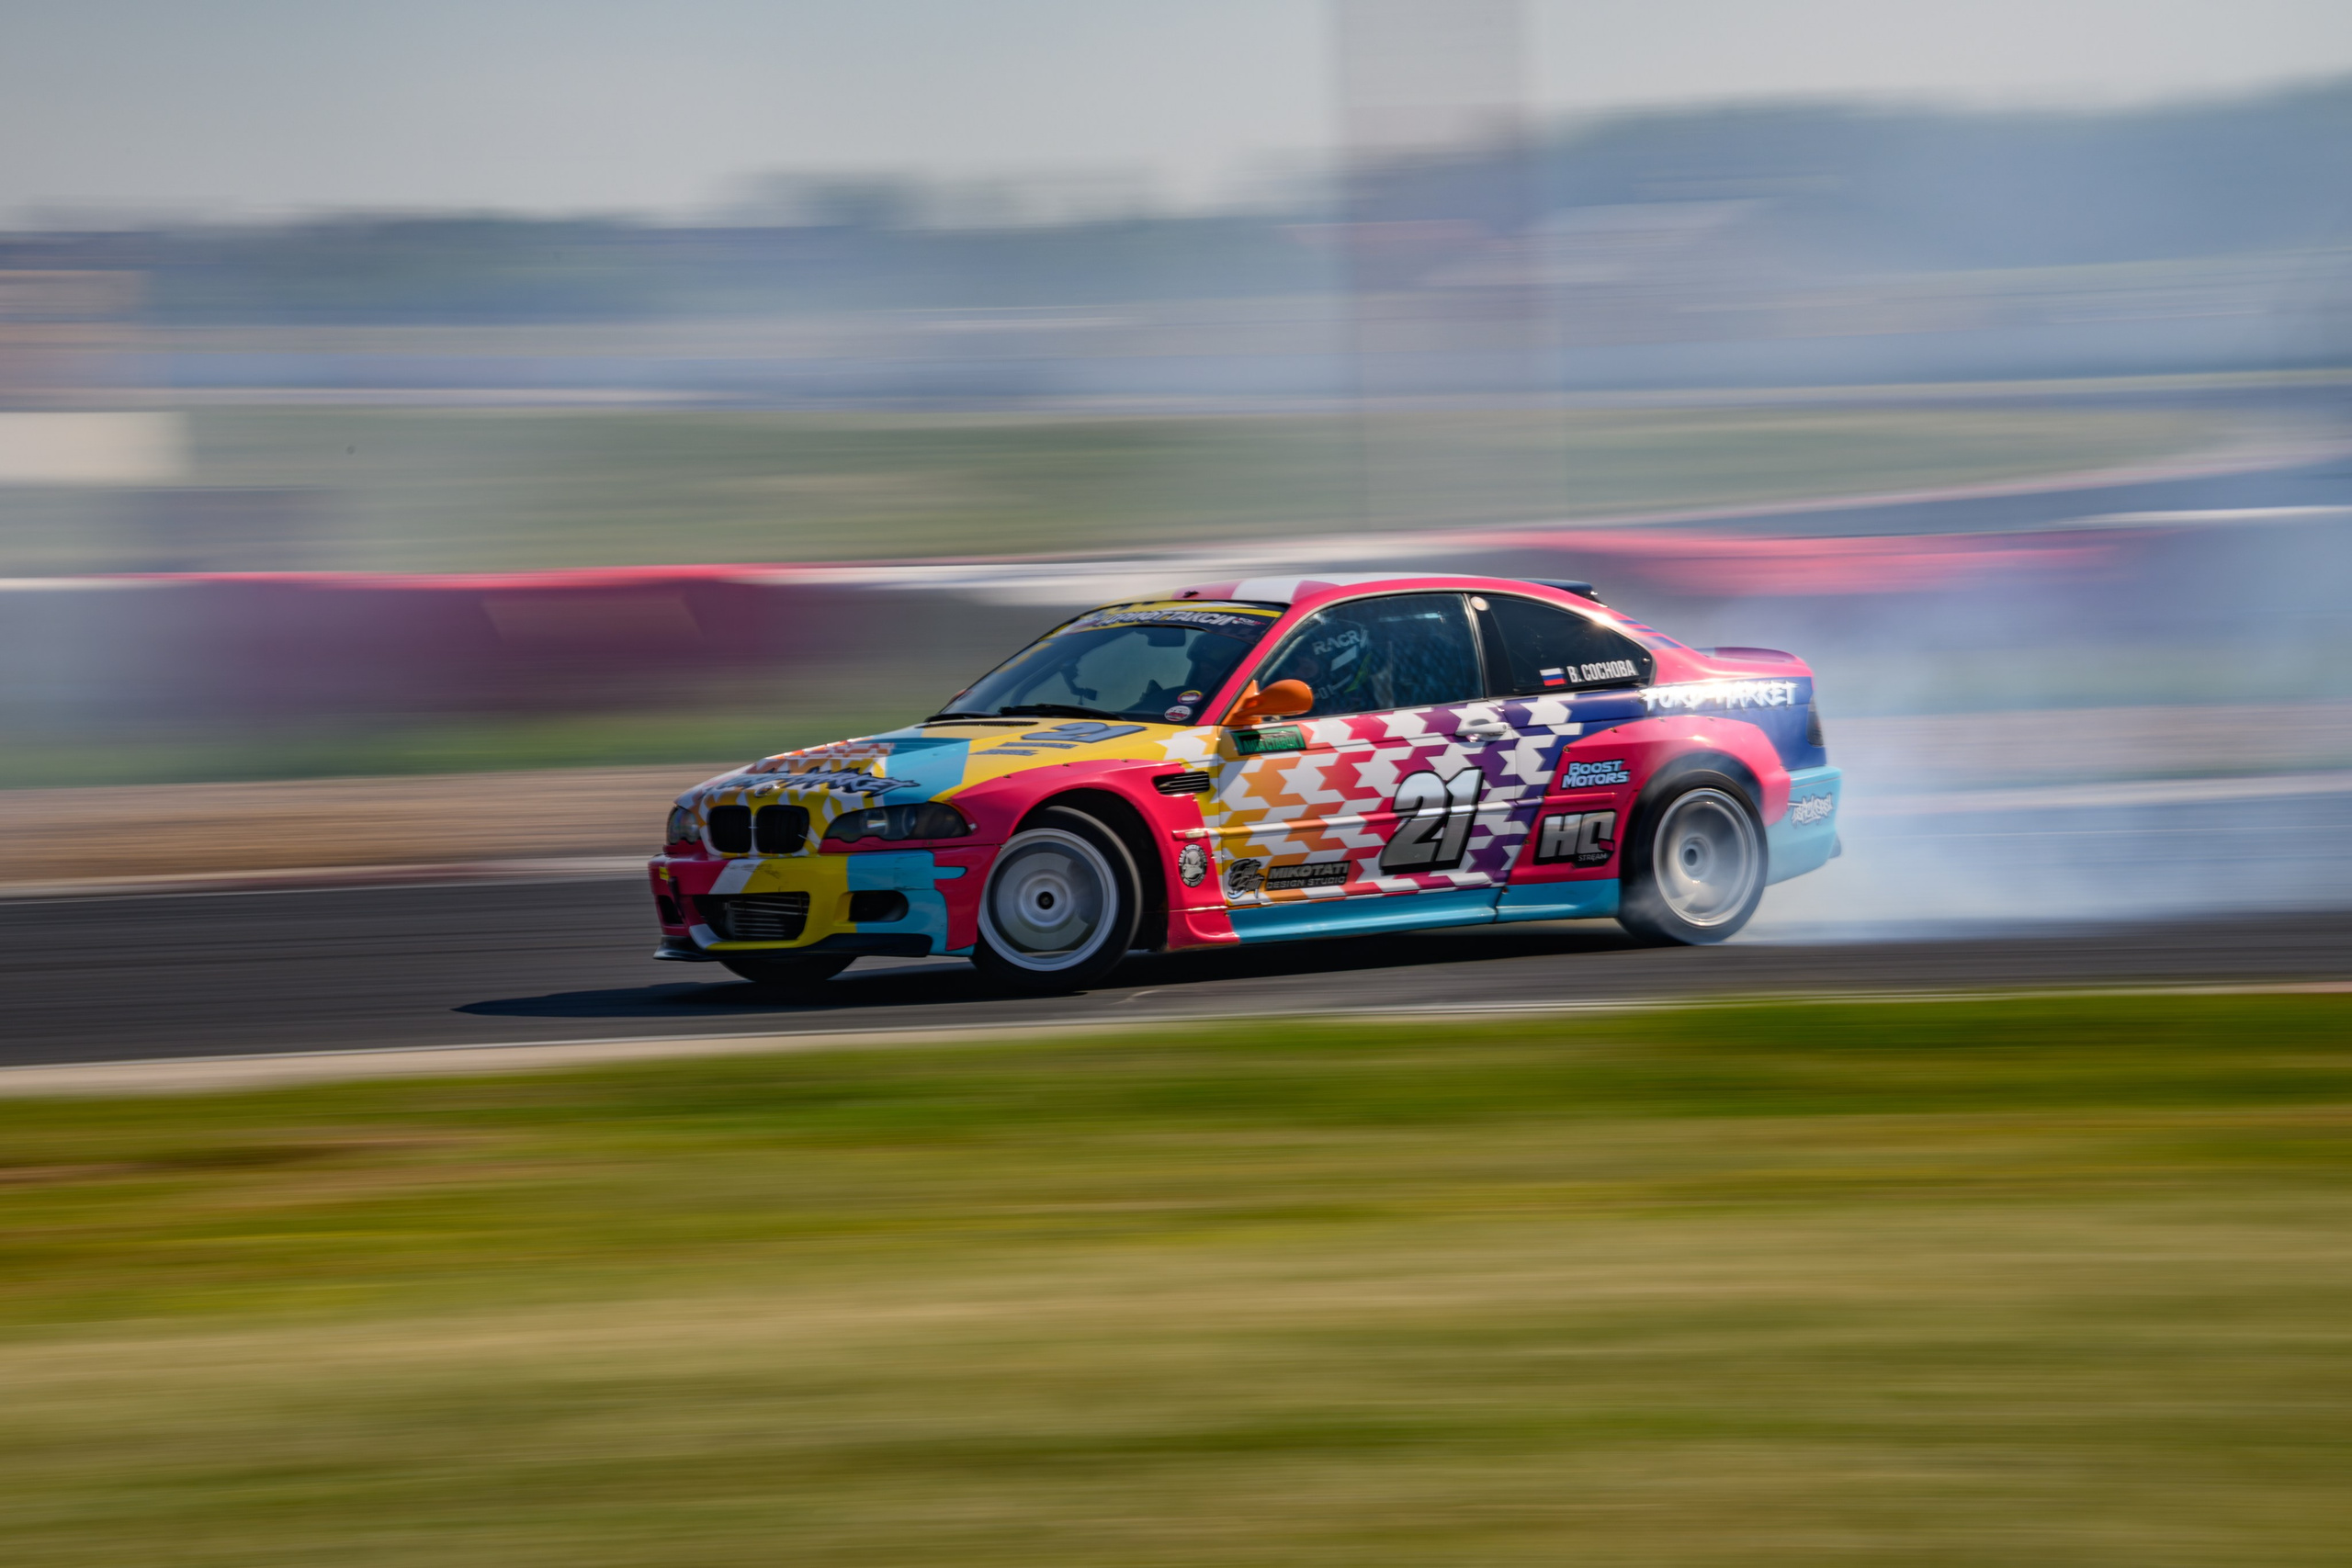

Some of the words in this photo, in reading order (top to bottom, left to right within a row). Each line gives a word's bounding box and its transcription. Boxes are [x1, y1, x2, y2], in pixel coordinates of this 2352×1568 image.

[1021, 722, 1148, 743] 21
[1568, 760, 1624, 775] BOOST
[1561, 770, 1631, 789] MOTORS
[1380, 767, 1483, 874] 21
[1578, 852, 1608, 862] STREAM
[1269, 863, 1350, 879] MIKOTATI
[1266, 879, 1306, 890] DESIGN
[1306, 876, 1347, 887] STUDIO
